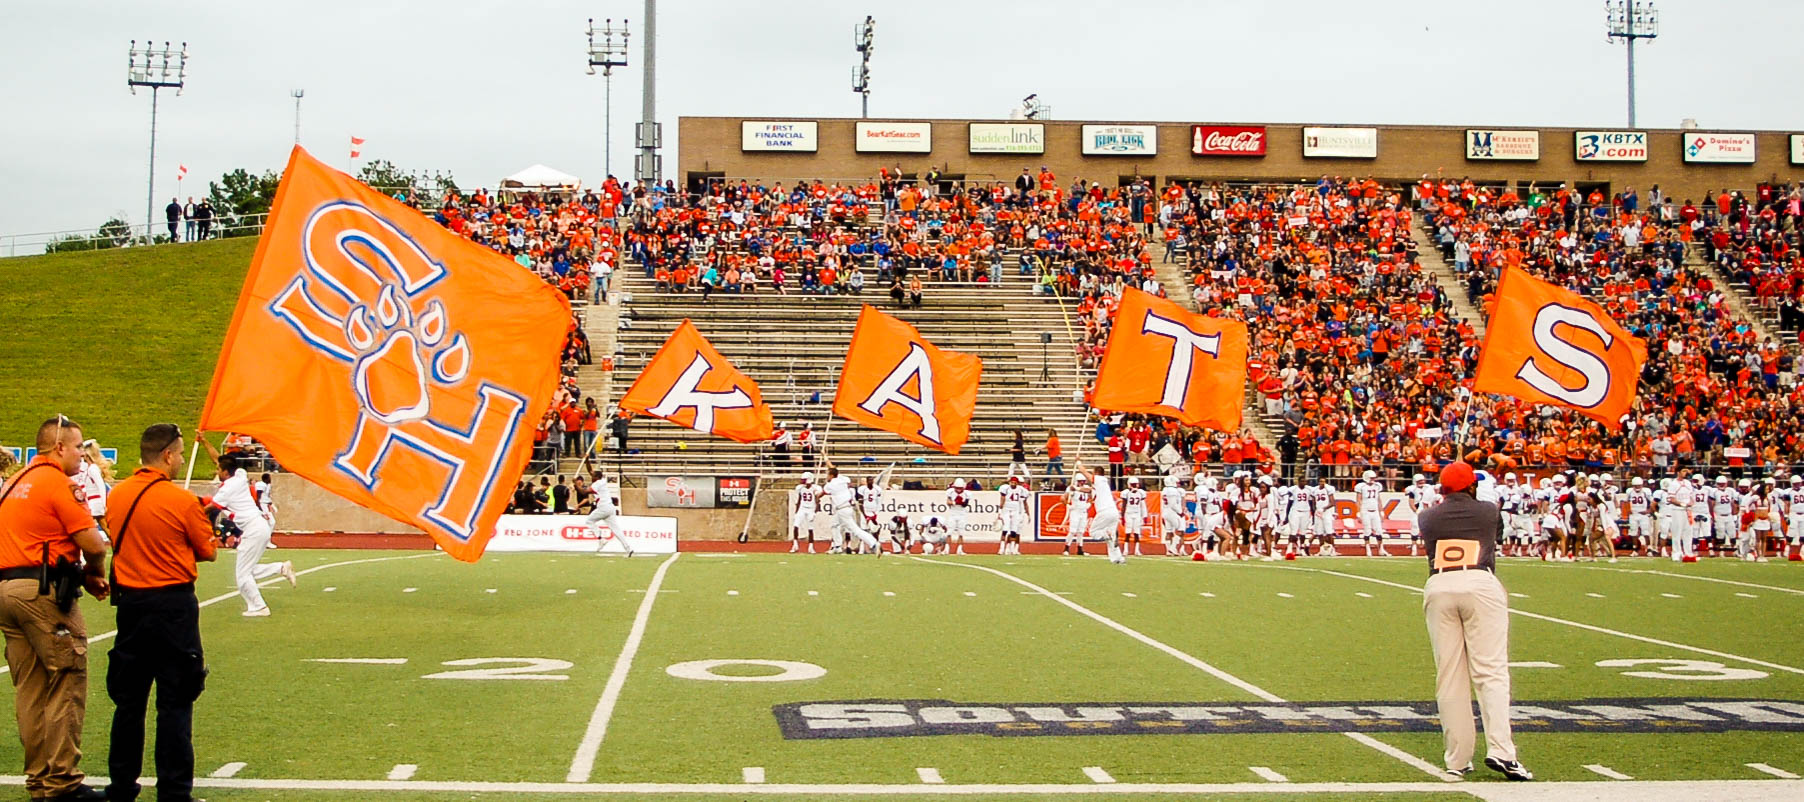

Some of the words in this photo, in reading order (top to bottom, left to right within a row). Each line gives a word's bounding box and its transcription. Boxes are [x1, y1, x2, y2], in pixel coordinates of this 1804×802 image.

[1205, 132, 1262, 151] Coca-Cola
[1602, 134, 1644, 144] KBTX
[646, 349, 754, 433] K
[858, 341, 943, 445] A
[1141, 308, 1221, 412] T
[1516, 301, 1613, 409] S
